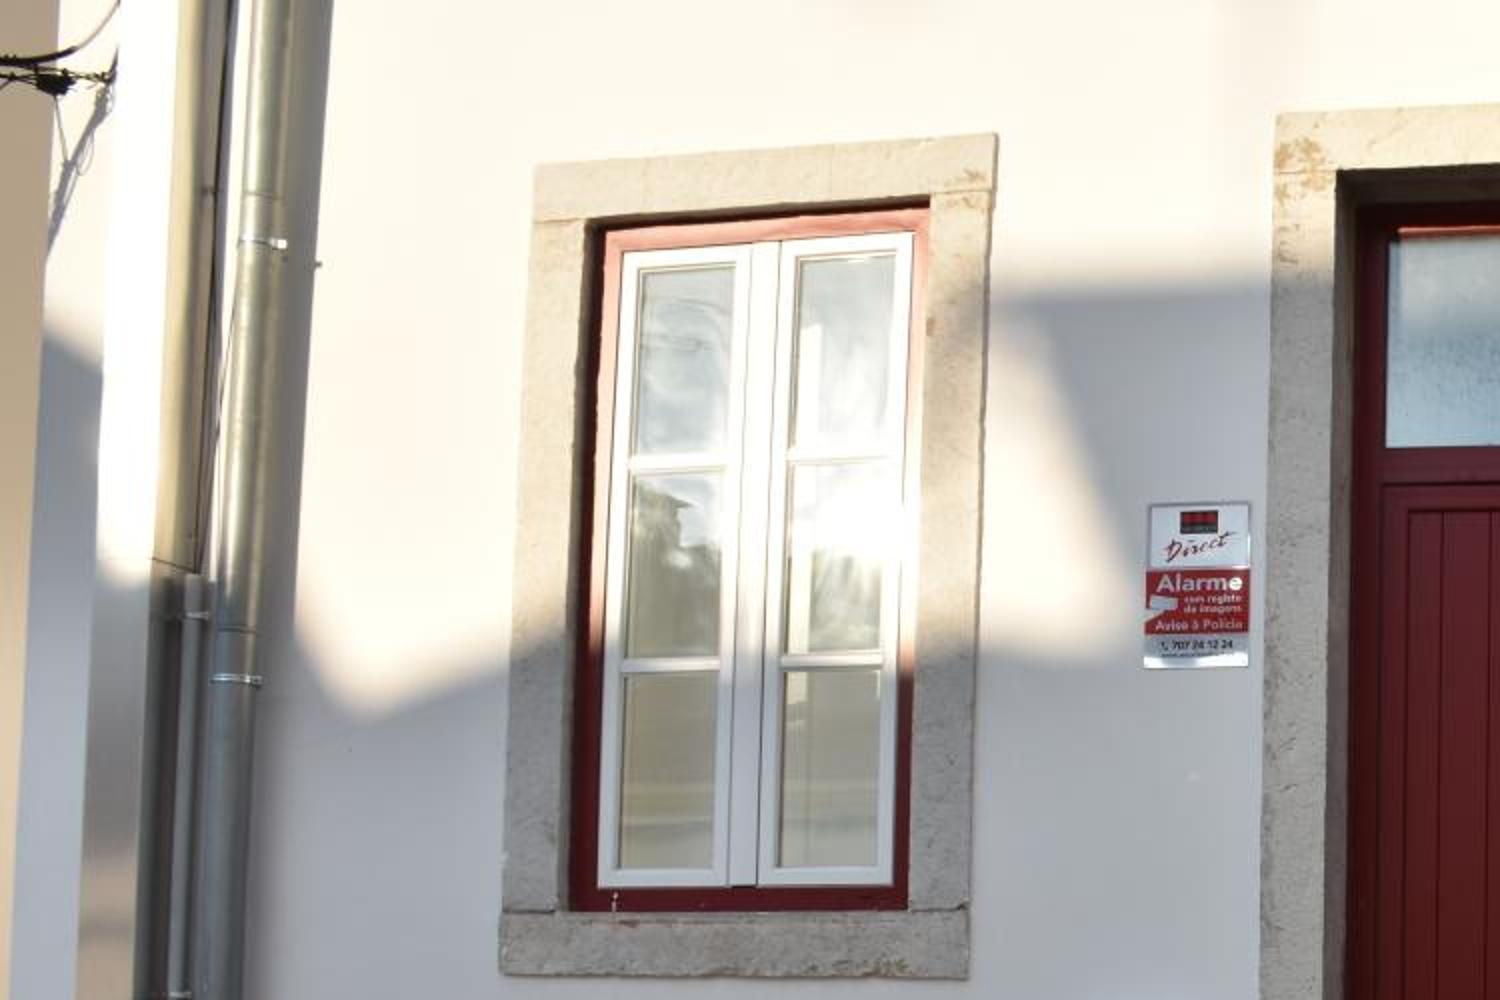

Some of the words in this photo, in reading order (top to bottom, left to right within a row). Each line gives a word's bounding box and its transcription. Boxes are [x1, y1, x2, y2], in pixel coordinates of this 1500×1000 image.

[1164, 532, 1236, 562] Direct
[1156, 573, 1243, 592] Alarme
[1155, 619, 1188, 631] Aviso
